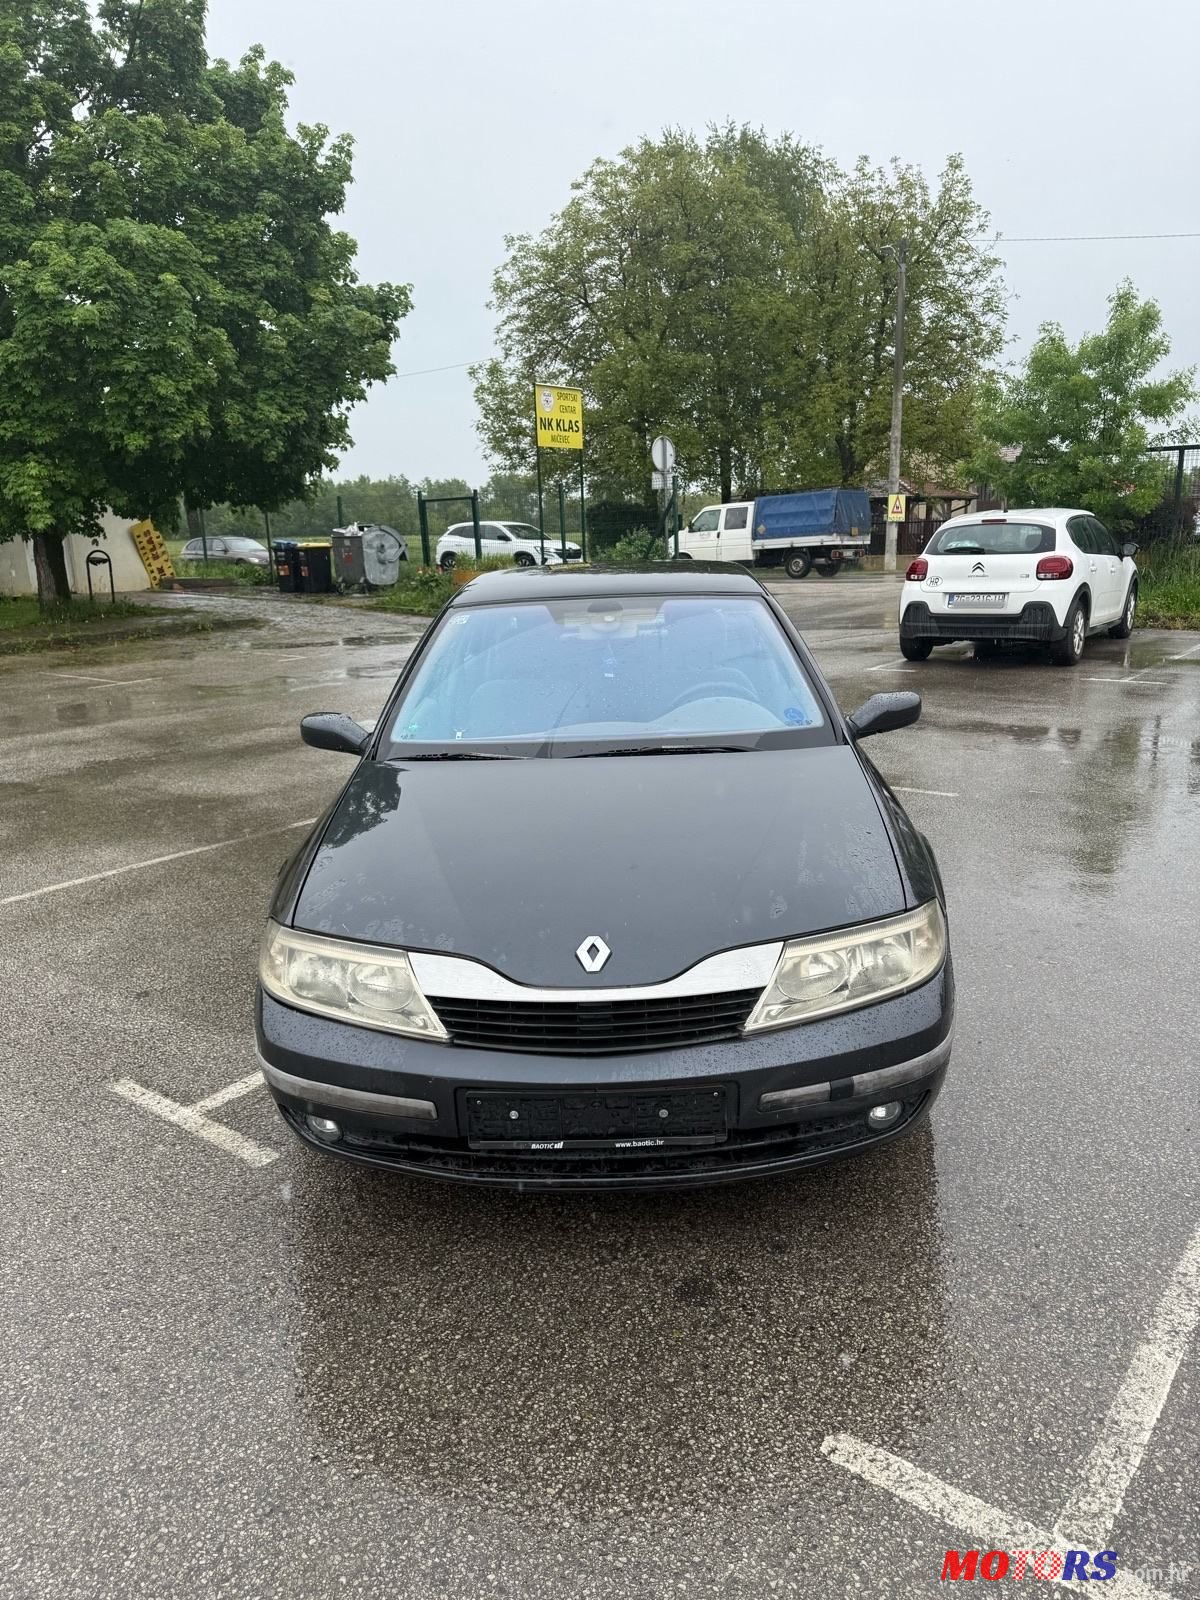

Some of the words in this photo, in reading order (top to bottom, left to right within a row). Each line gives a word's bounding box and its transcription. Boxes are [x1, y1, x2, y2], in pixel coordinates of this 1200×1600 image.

[556, 391, 578, 402] SPORTSKI
[559, 404, 577, 414] CENTAR
[539, 416, 554, 431] NK
[555, 418, 580, 433] KLAS
[929, 577, 940, 586] HR
[615, 1139, 665, 1149] www.baotic.hr
